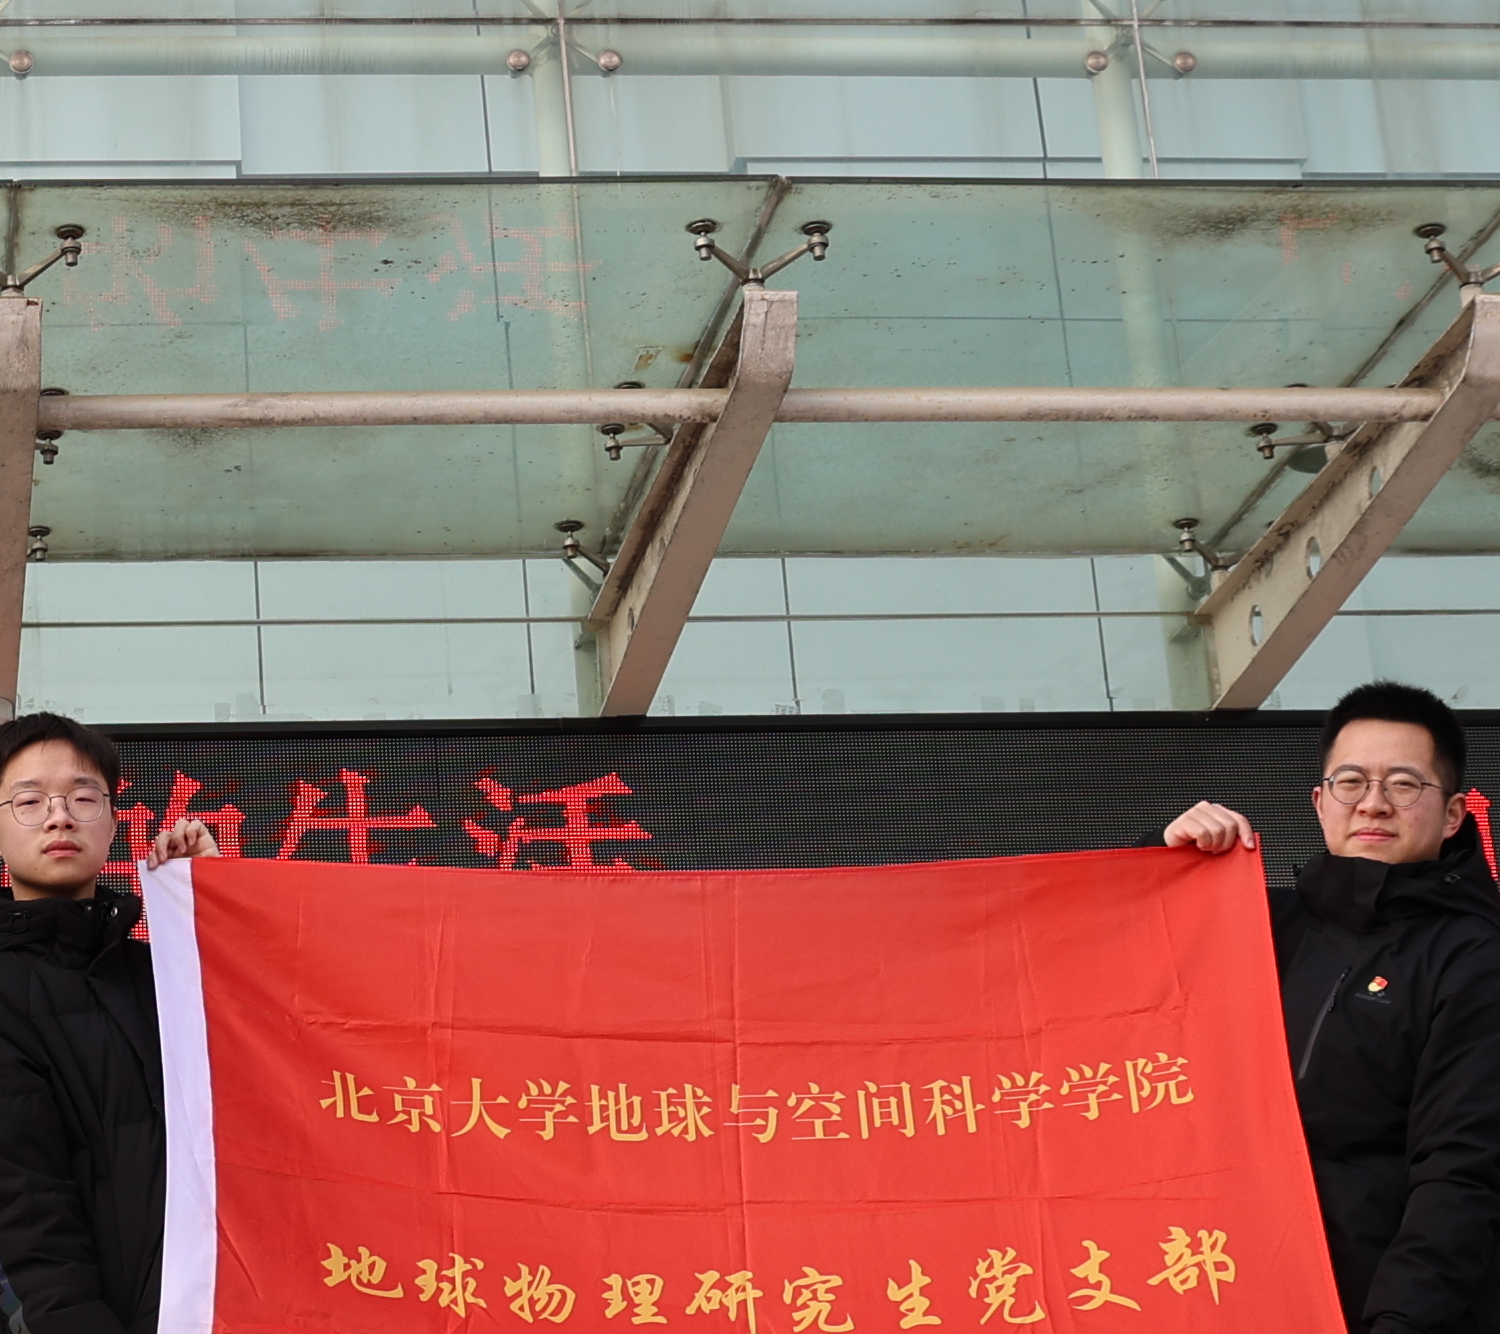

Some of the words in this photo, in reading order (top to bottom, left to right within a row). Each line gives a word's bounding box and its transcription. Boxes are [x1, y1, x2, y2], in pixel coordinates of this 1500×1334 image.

[318, 1051, 1196, 1142] 北京大学地球与空间科学学院
